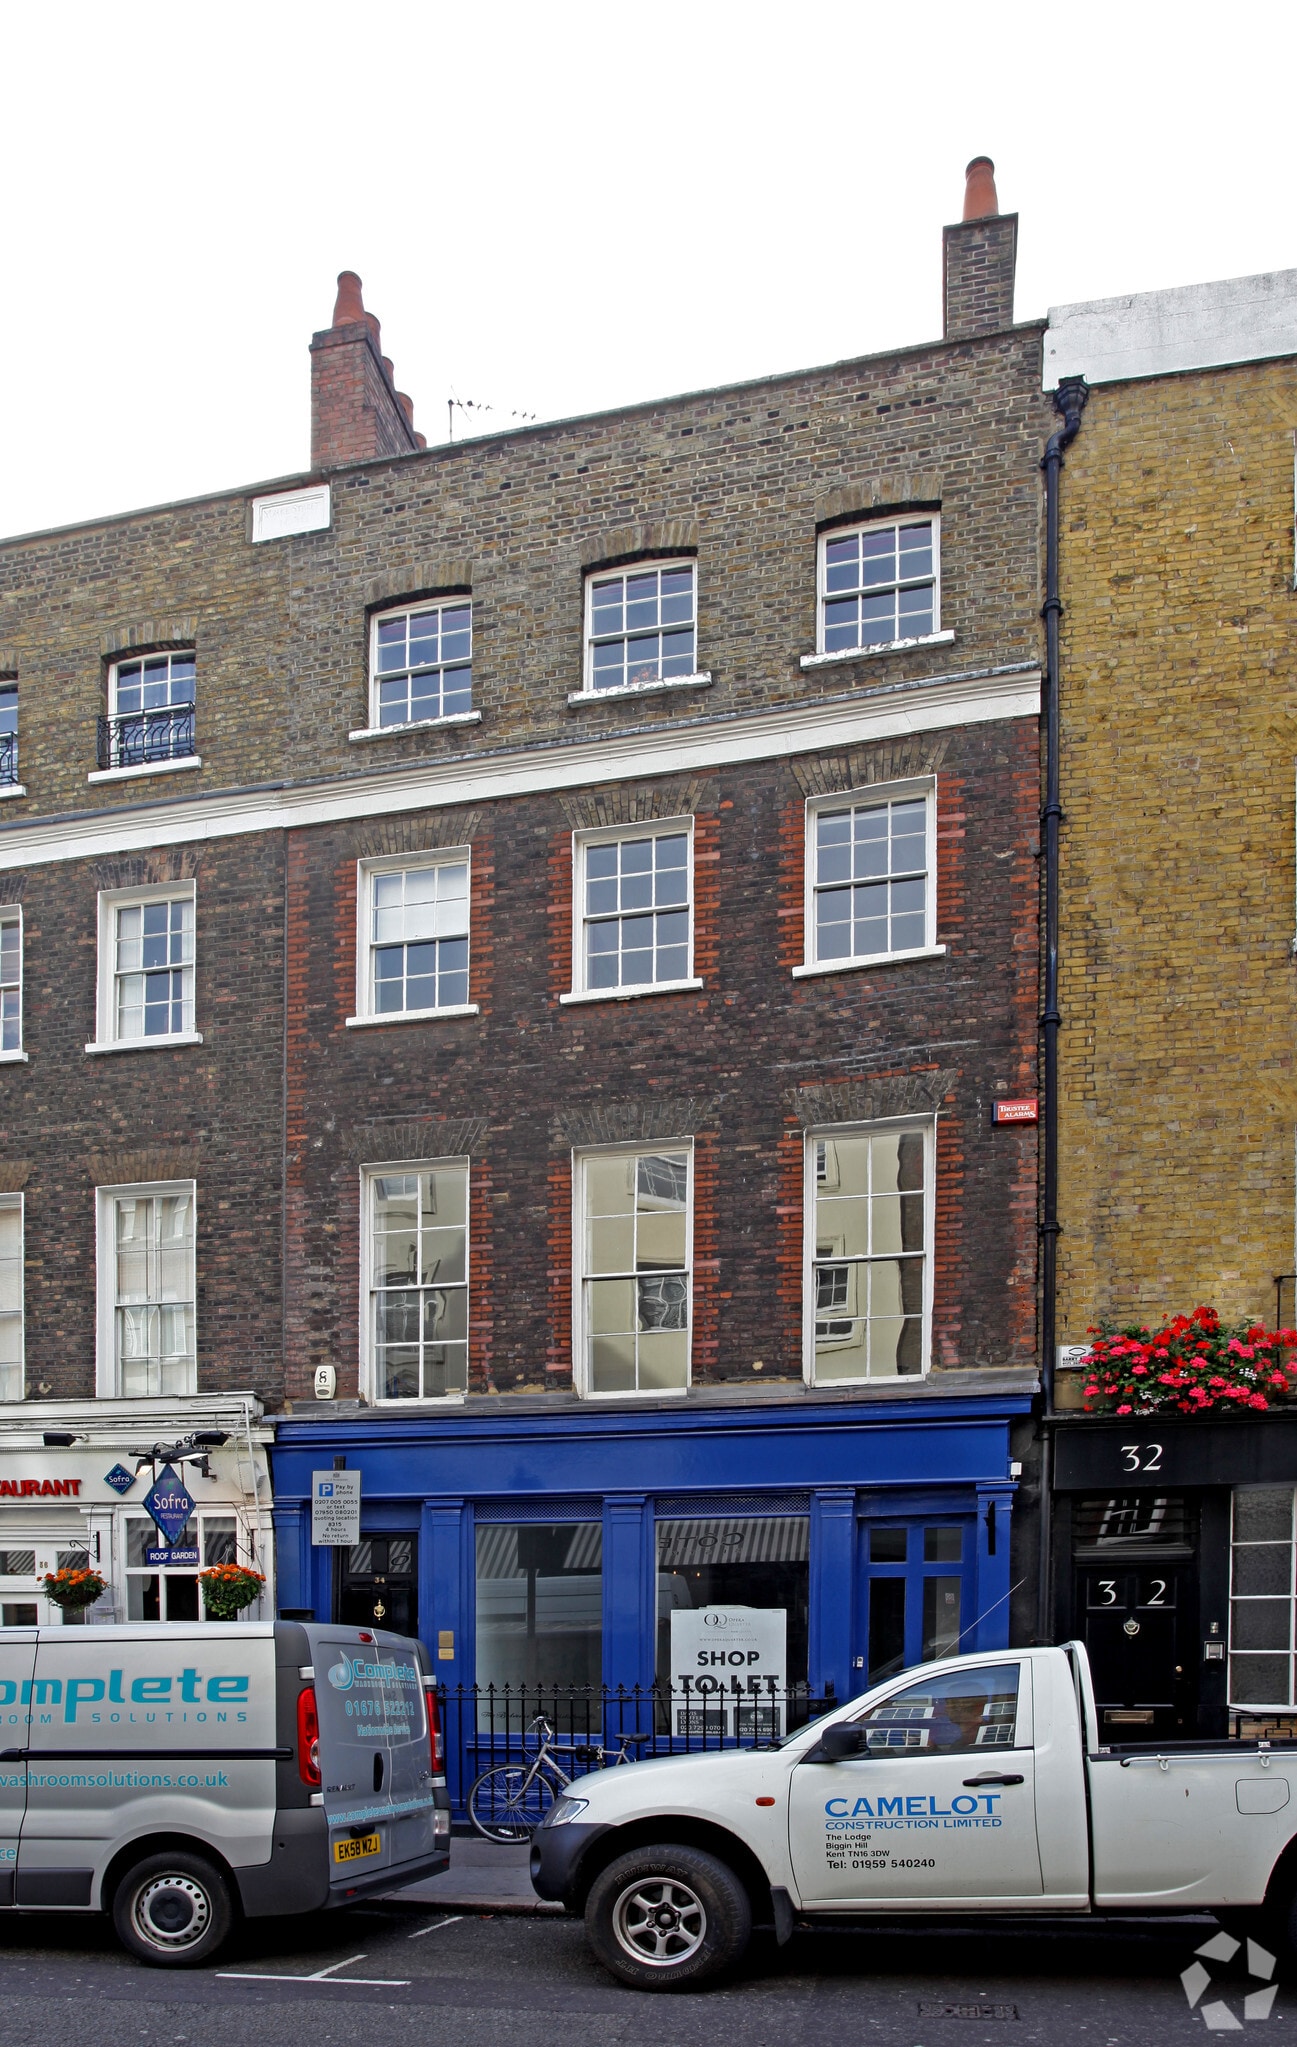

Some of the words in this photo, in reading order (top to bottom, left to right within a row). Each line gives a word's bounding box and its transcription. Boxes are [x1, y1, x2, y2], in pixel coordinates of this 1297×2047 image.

[1120, 1444, 1163, 1471] 32
[0, 1479, 81, 1497] AURANT
[322, 1484, 332, 1496] P
[153, 1493, 188, 1510] Sofra
[150, 1552, 169, 1560] ROOF
[171, 1551, 197, 1560] GARDEN
[374, 1576, 385, 1584] 34
[1098, 1580, 1117, 1605] 3
[1146, 1580, 1166, 1605] 2
[697, 1650, 760, 1667] SHOP
[353, 1659, 416, 1688] Complete
[678, 1674, 719, 1695] TO
[730, 1674, 780, 1694] LET
[345, 1700, 381, 1716] 01676
[92, 1712, 247, 1723] SOLUTIONS
[824, 1794, 1001, 1818] CAMELOT
[825, 1820, 939, 1831] CONSTRUCTION
[943, 1819, 1002, 1828] LIMITED
[844, 1833, 872, 1842] Lodge
[338, 1841, 361, 1860] EK58
[362, 1837, 378, 1854] MZJ
[826, 1842, 852, 1850] Biggin
[827, 1860, 847, 1869] Tel:
[852, 1860, 887, 1869] 01959
[891, 1858, 936, 1868] 540240
